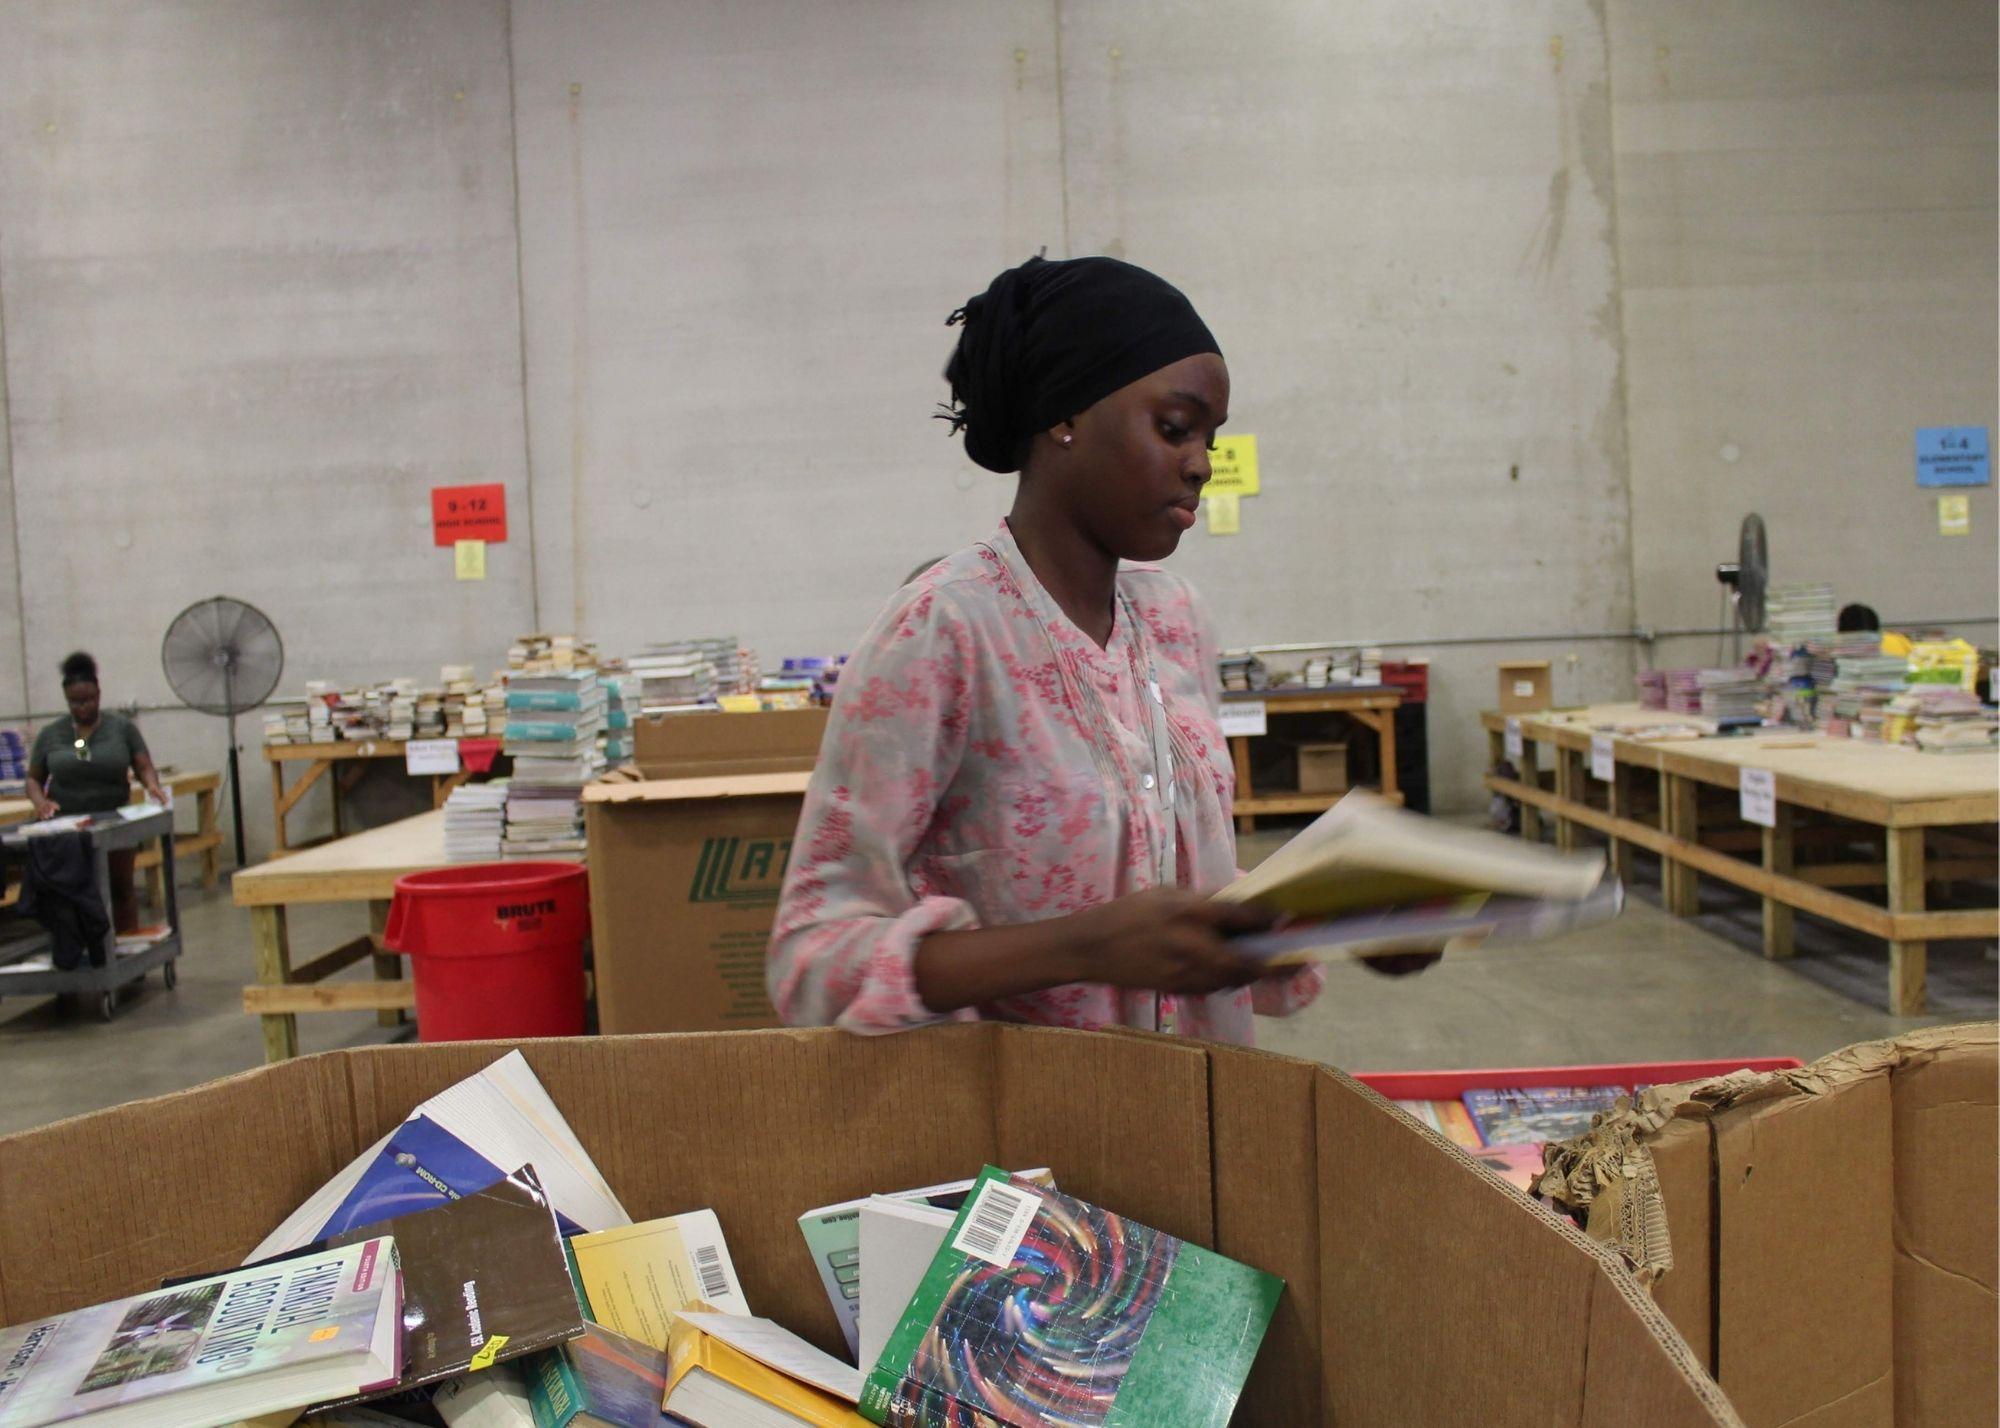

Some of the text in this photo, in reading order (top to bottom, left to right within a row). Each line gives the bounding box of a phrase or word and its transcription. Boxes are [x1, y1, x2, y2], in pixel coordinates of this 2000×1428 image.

[436, 517, 501, 529] HIGH SCHOOL
[496, 899, 556, 920] BRUTE
[415, 1166, 448, 1193] CD-ROM
[271, 1260, 344, 1335] FINANCIAL
[196, 1275, 284, 1364] ACCOUNTING
[5, 1323, 58, 1372] Harrison
